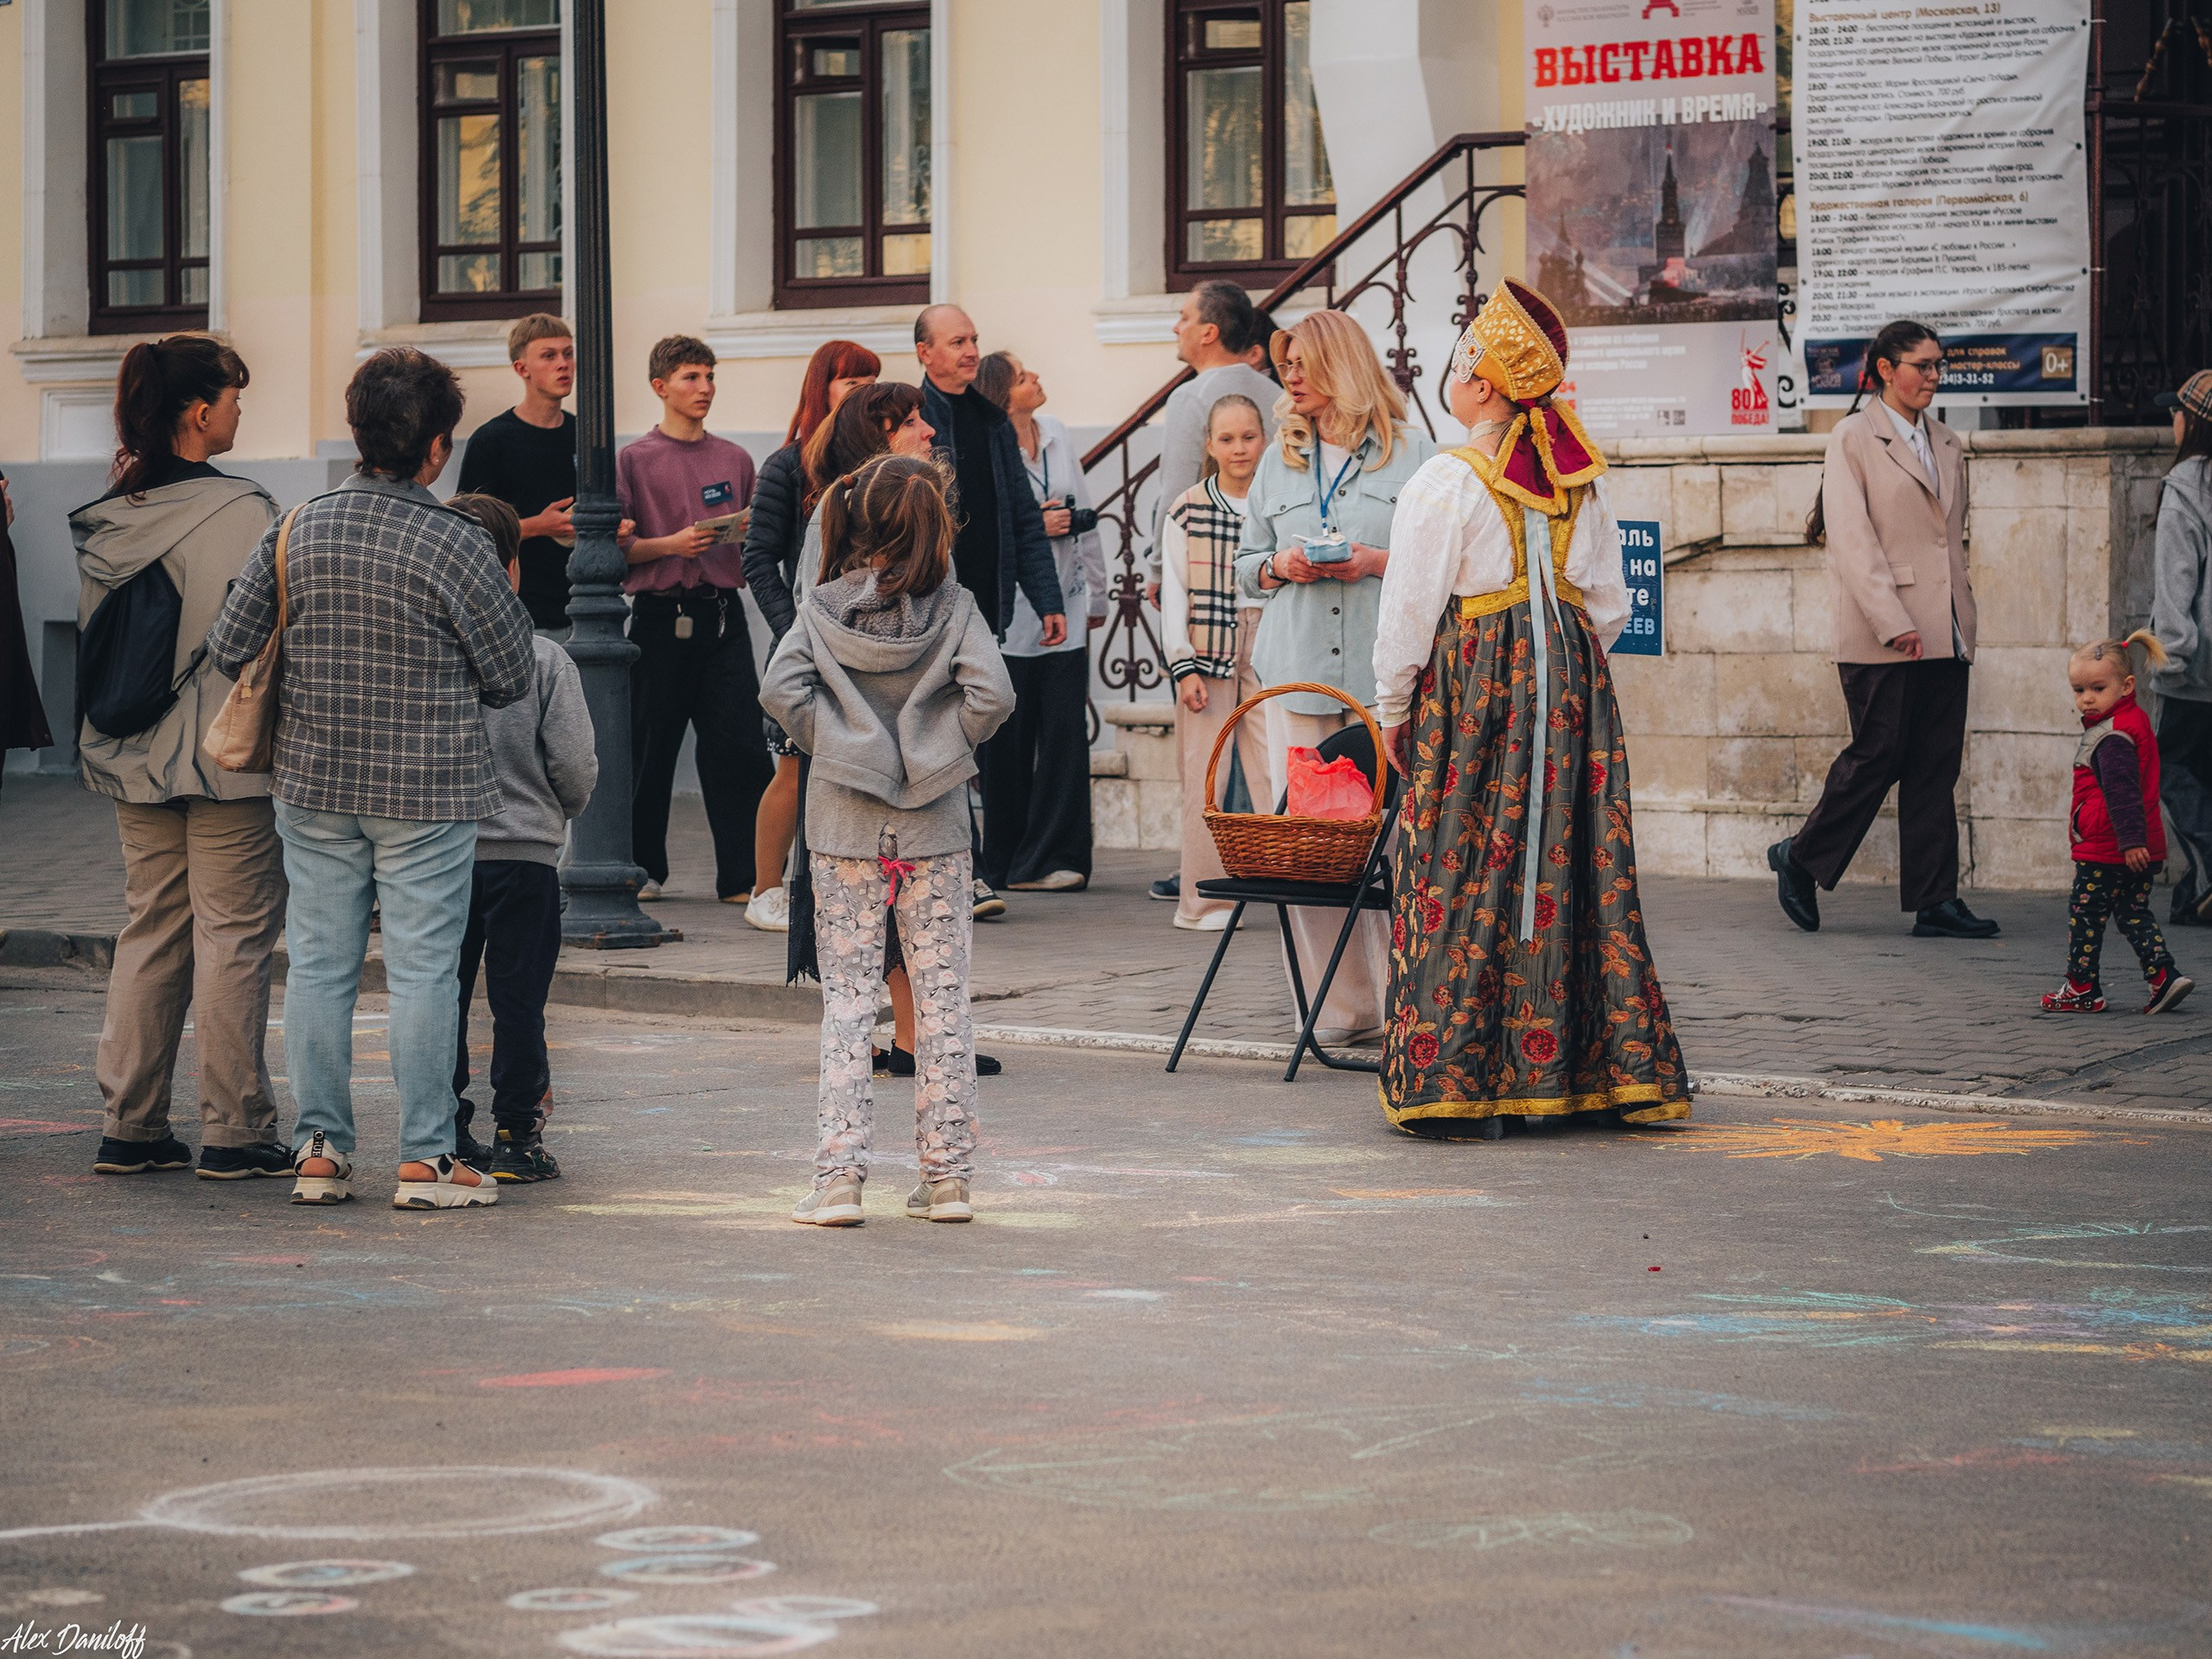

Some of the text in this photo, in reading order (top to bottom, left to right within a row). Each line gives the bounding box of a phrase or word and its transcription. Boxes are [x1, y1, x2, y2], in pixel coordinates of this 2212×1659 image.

[1880, 10, 1911, 20] центр
[1984, 2, 2000, 14] 13)
[1808, 26, 1829, 35] 18:00
[1837, 24, 1858, 34] 24:00
[1535, 33, 1764, 88] ВЫСТАВКА
[1808, 81, 1827, 91] 18:00
[1531, 92, 1768, 135] «ХУДОЖНИК И ВРЕМЯ»
[1807, 104, 1827, 113] 20:00
[1831, 137, 1851, 146] 21:00
[1832, 170, 1853, 180] 22:00
[1809, 199, 1890, 211] Художественная
[1892, 197, 1932, 207] галерея
[1810, 213, 1831, 223] 18:00
[1839, 213, 1858, 221] 24:00
[1812, 247, 1833, 256] 18:00
[1837, 268, 1858, 277] 22:00
[1947, 348, 1965, 357] для
[2044, 353, 2069, 373] 0+
[1731, 388, 1751, 410] 80
[1731, 414, 1770, 425] ПОБЕДА!
[1618, 529, 1655, 547] аль
[1630, 558, 1656, 576] на
[1626, 588, 1649, 606] те
[1623, 617, 1656, 635] ЕЕВ
